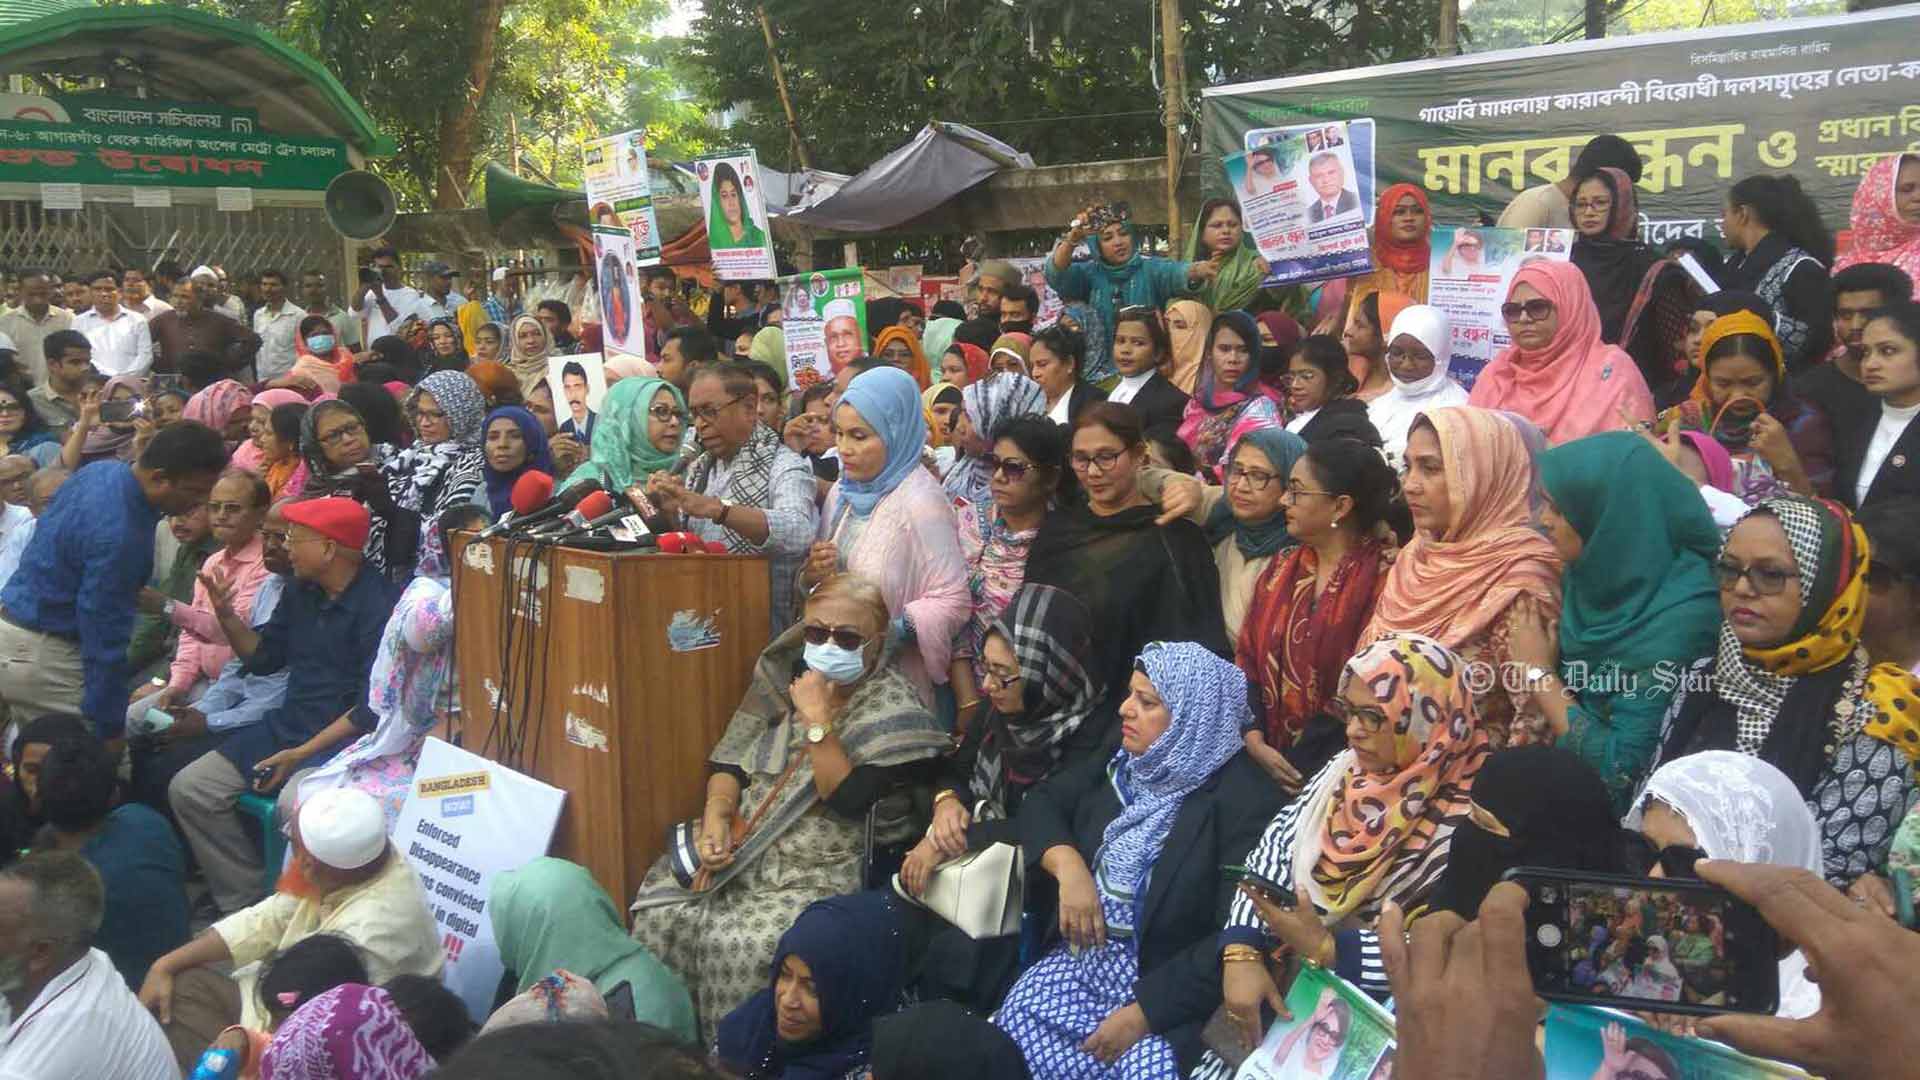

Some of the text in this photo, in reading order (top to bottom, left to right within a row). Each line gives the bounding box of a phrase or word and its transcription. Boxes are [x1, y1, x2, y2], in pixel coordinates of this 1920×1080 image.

[1418, 99, 1478, 124] গায়েবি
[1479, 96, 1551, 117] মামলায়
[1553, 80, 1642, 111] কারাবন্দী
[1645, 73, 1721, 105] বিরোধী
[1723, 69, 1833, 99] দলসমূহের
[82, 108, 221, 128] বাংলাদেশ সচিবালয়
[1817, 116, 1895, 143] প্রধান
[107, 133, 140, 146] থেকে
[144, 134, 192, 149] মতিঝিল
[241, 141, 271, 155] মেট্রো
[1758, 130, 1798, 168] ও
[97, 147, 271, 178] উদ্বোধন
[416, 818, 461, 848] Enforced
[409, 841, 482, 885] Disappearance
[435, 882, 486, 914] convicted
[434, 905, 480, 939] in digital
